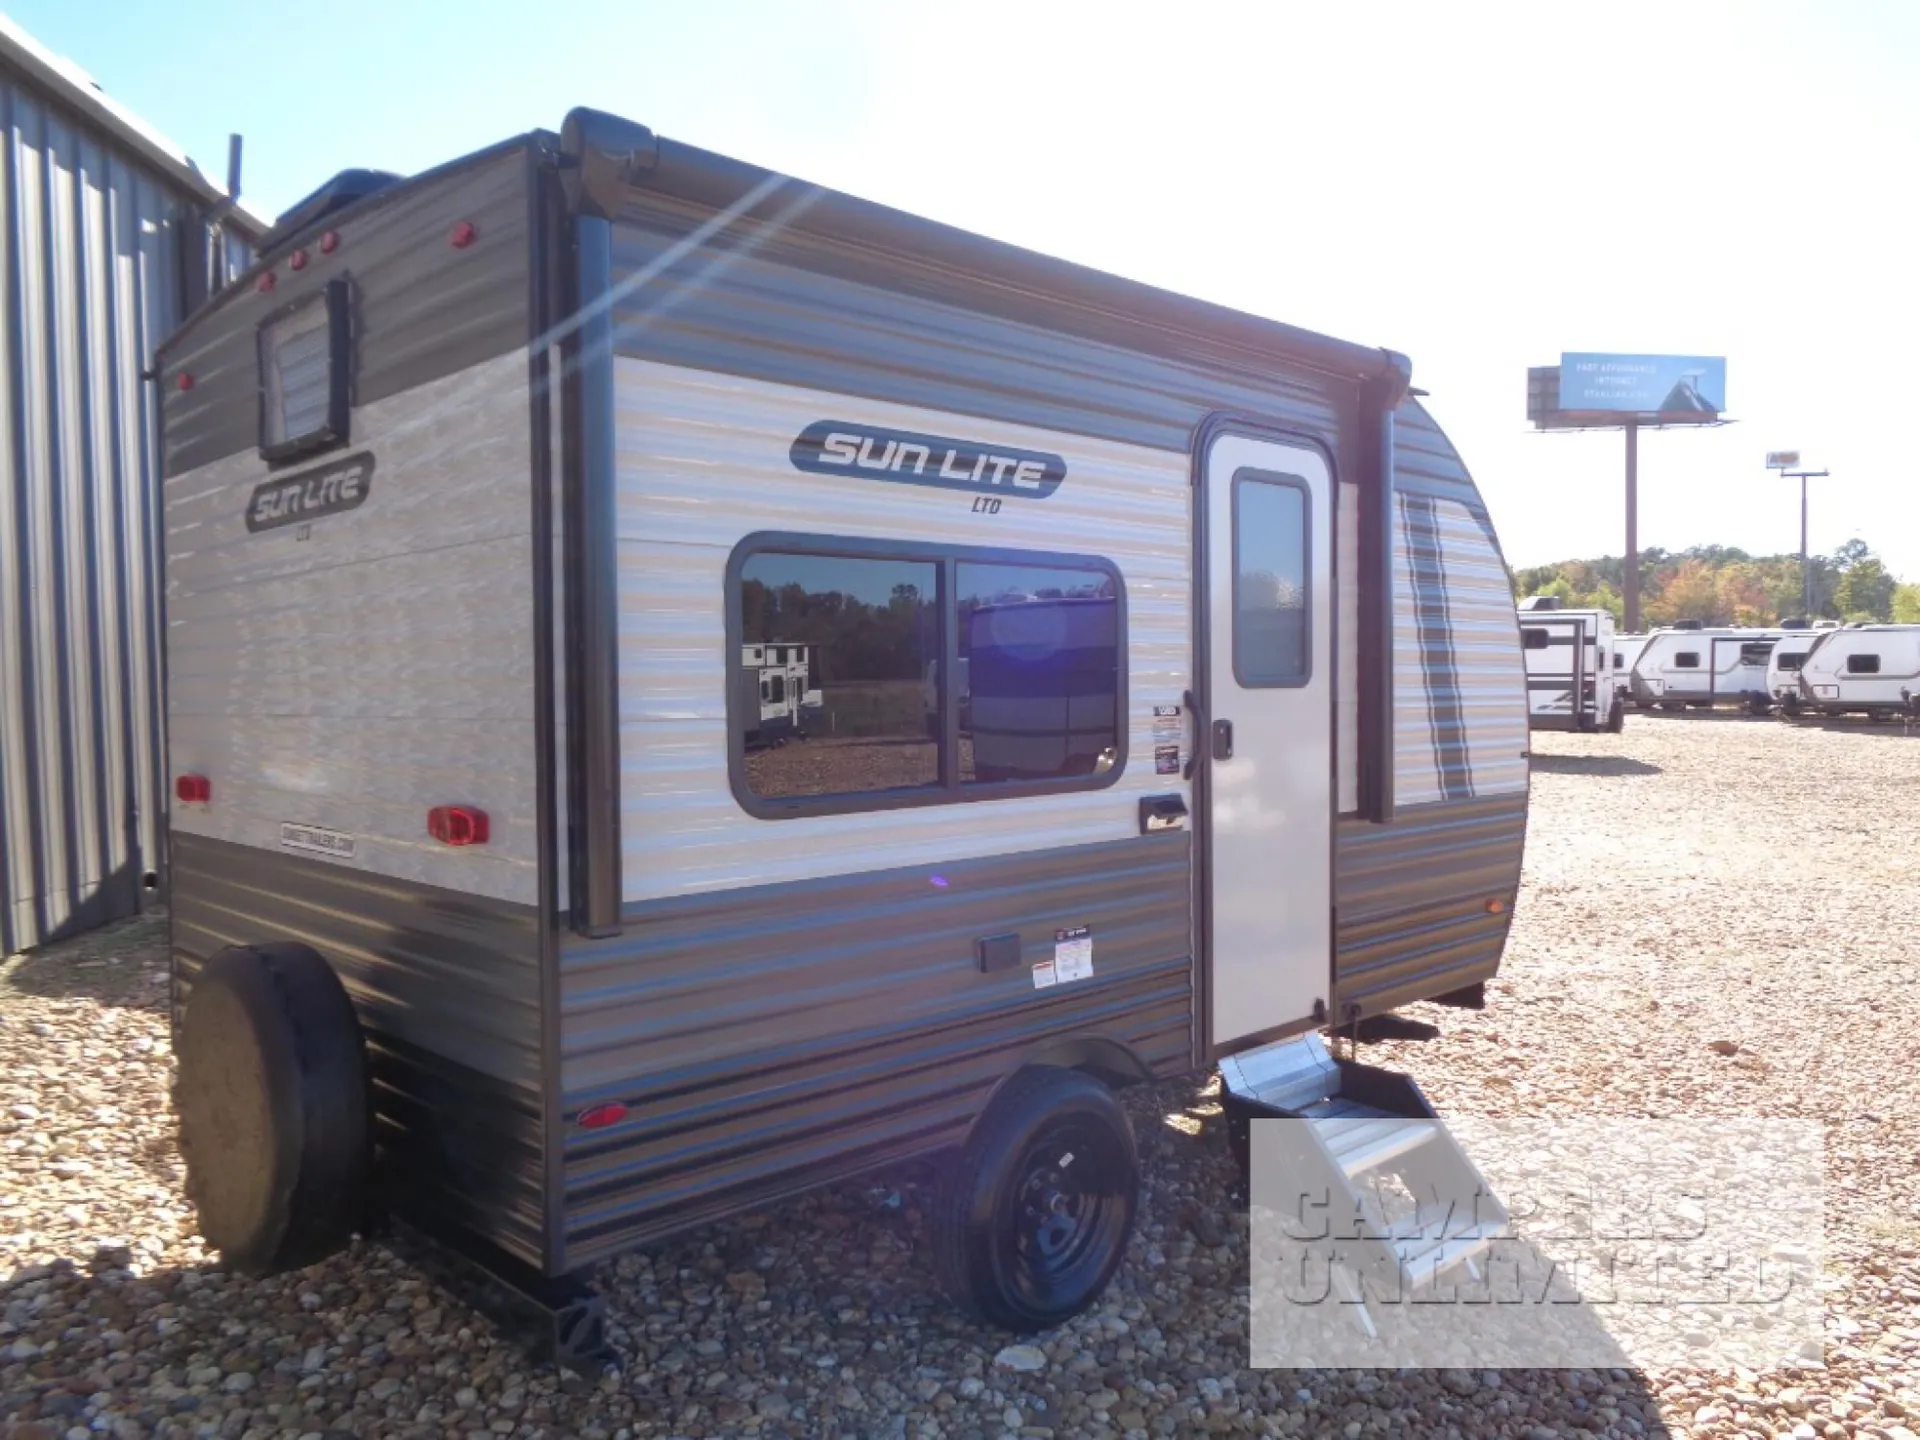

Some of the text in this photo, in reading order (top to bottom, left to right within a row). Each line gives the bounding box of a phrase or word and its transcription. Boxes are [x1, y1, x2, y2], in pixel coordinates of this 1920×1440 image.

[818, 432, 1047, 489] SUN LITE
[303, 466, 364, 510] LITE
[971, 496, 1002, 514] LTD
